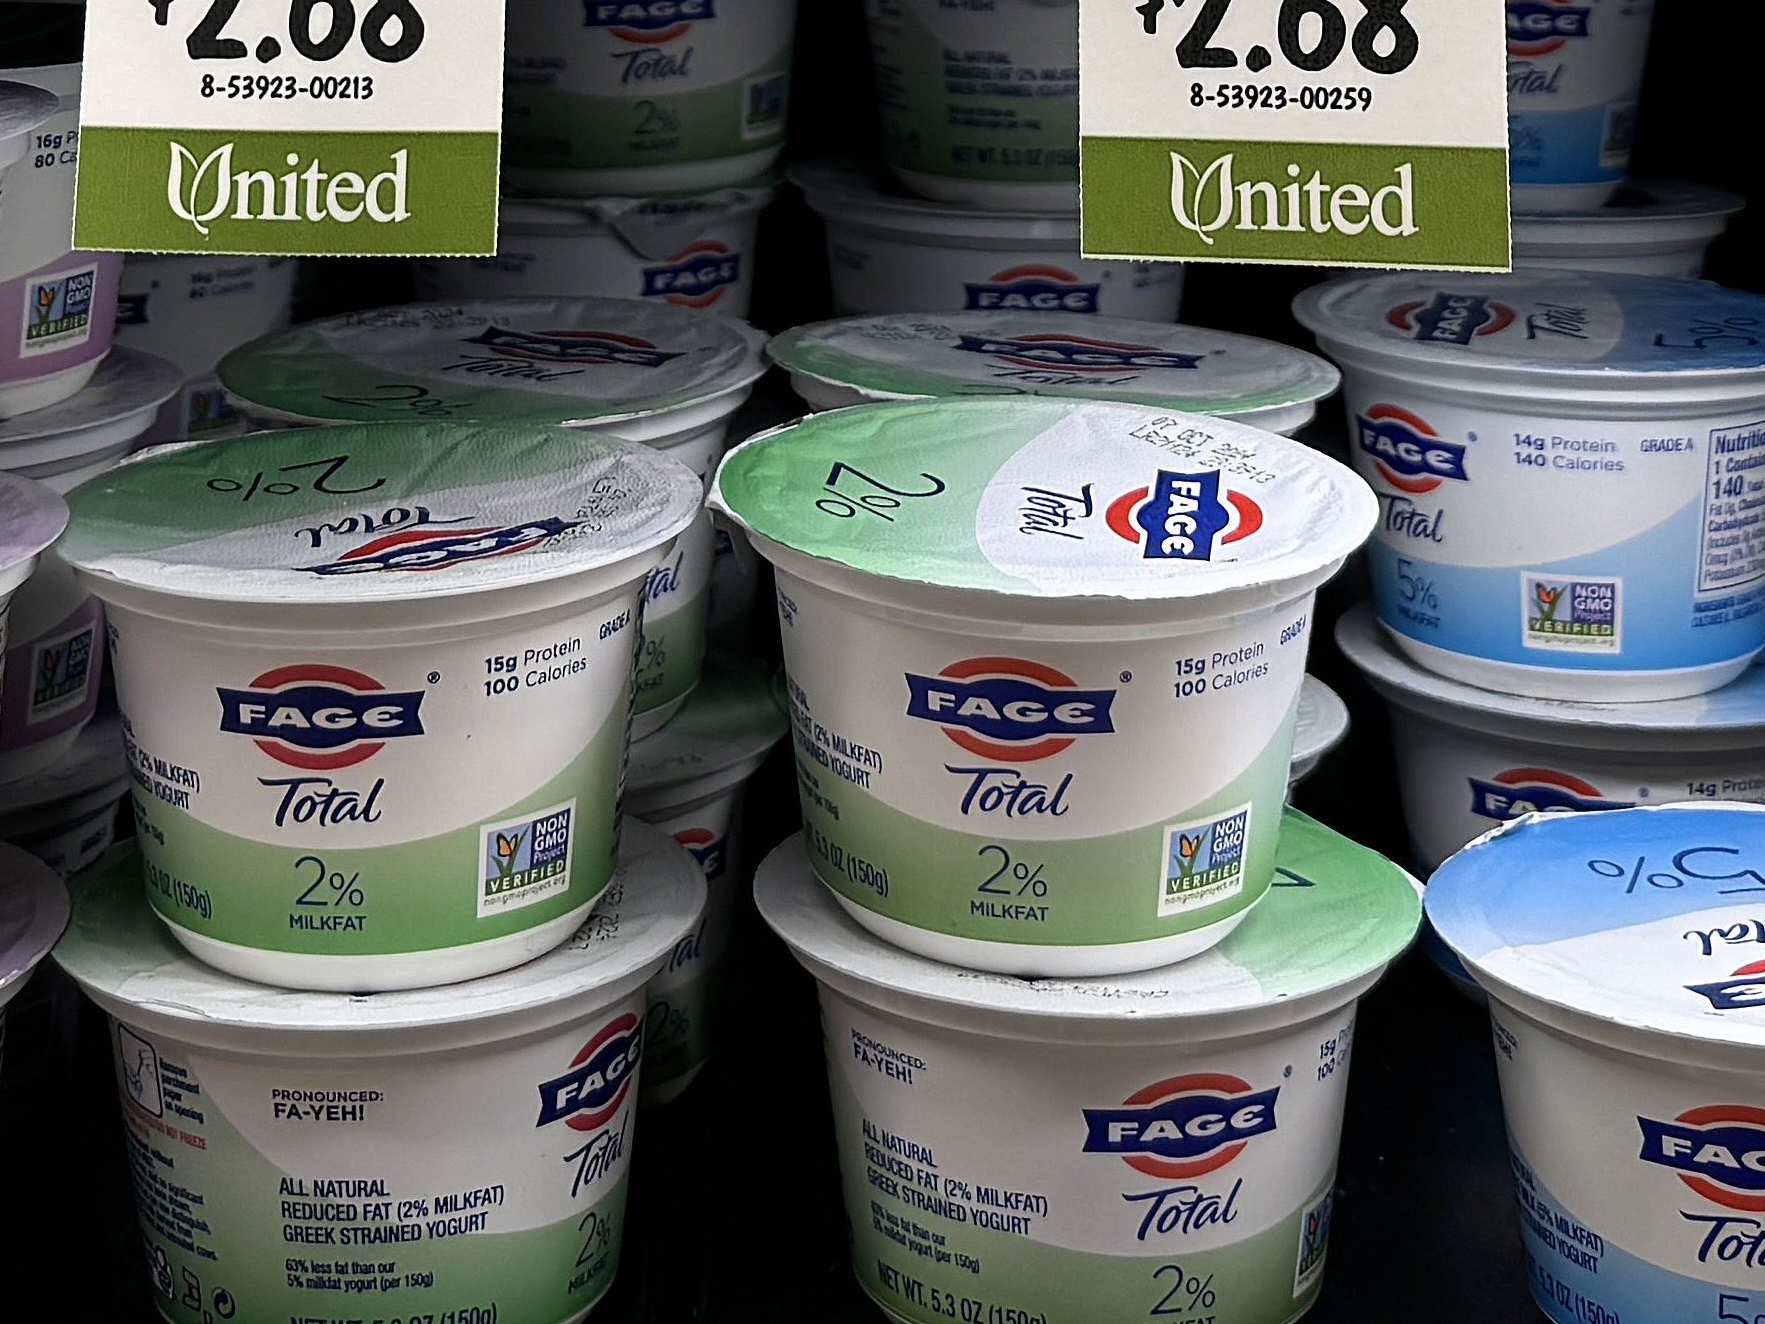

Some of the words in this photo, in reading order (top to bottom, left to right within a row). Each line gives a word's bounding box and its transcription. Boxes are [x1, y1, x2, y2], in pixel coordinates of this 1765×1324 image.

[201, 73, 373, 101] 8-53923-00213
[1190, 84, 1372, 111] 8-53923-00259
[168, 143, 411, 235] United
[1171, 151, 1418, 246] United
[1174, 656, 1205, 676] 15g
[1212, 642, 1265, 664] Protein
[1174, 677, 1206, 697] 100
[1212, 661, 1269, 691] Calories
[926, 688, 1098, 726] FAGE
[944, 763, 1073, 818] Total
[977, 845, 1048, 897] 2%
[970, 899, 1048, 922] MILKFAT
